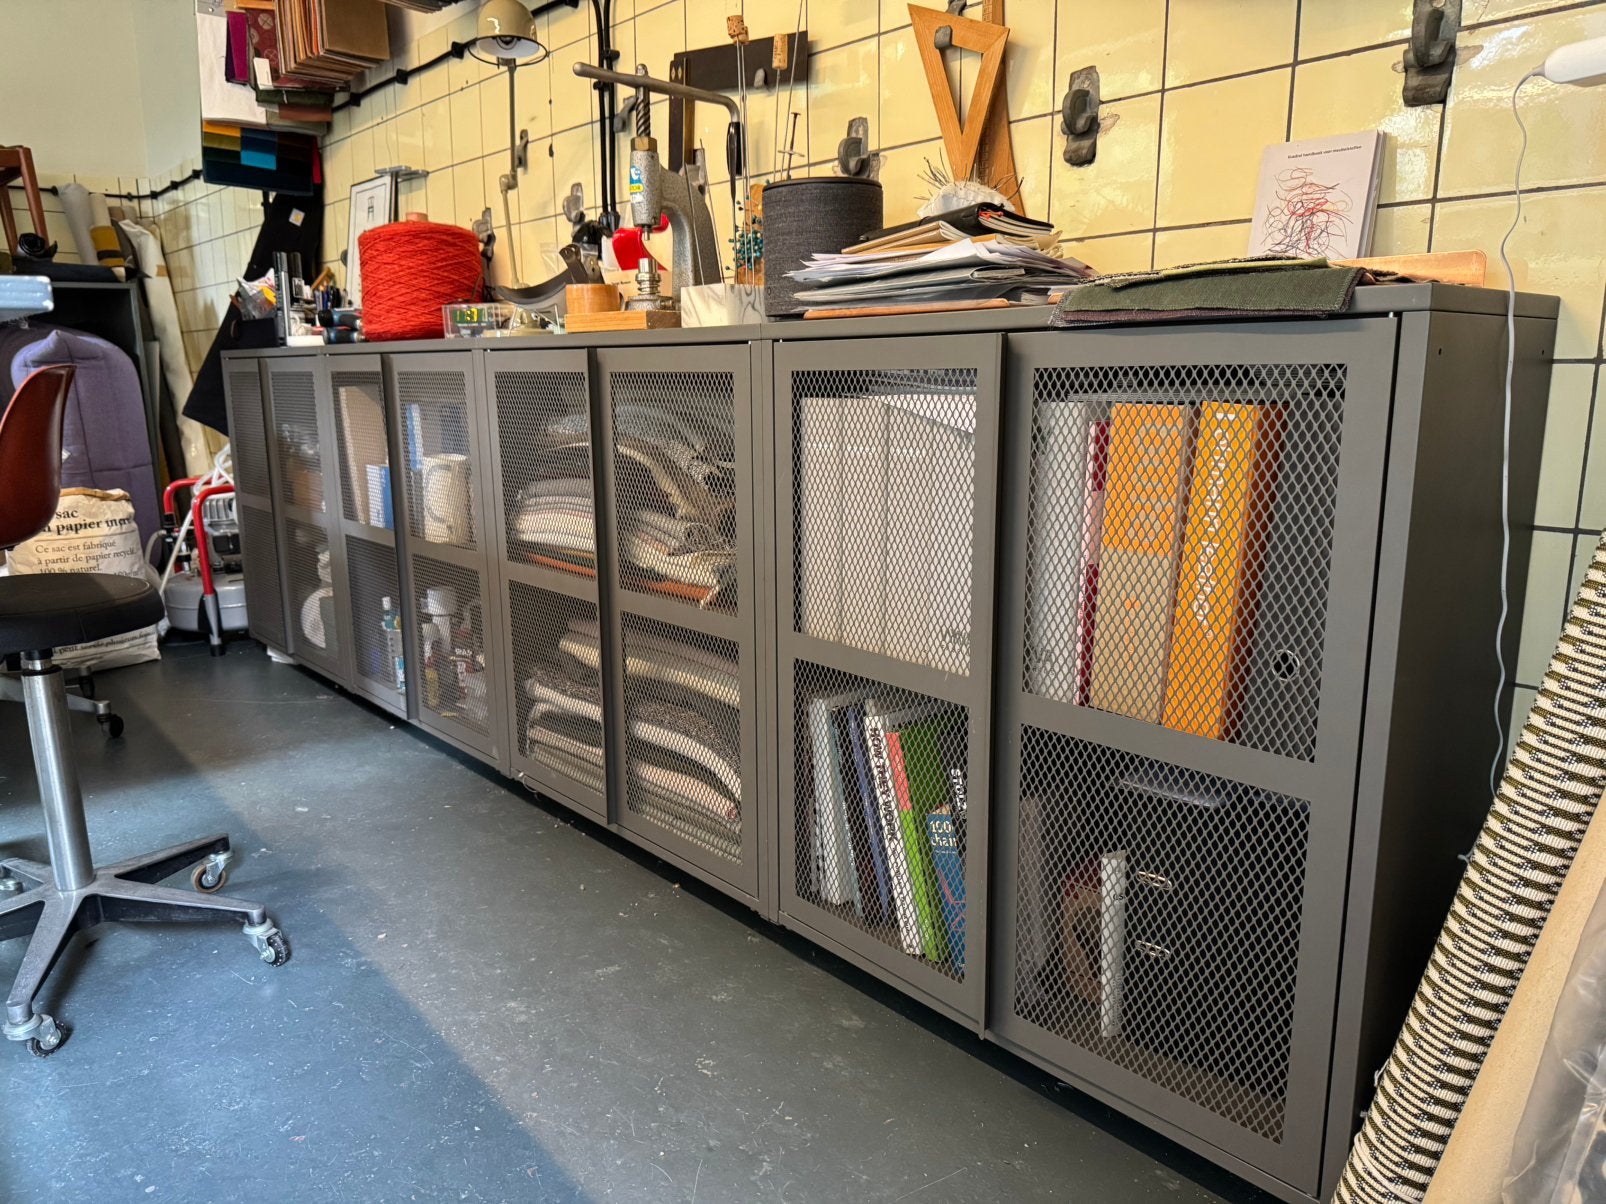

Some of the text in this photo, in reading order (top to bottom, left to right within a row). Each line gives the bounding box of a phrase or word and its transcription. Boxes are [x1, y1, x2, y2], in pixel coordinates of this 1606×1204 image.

[55, 509, 79, 519] sac
[56, 519, 103, 535] papier
[35, 545, 49, 553] Ce
[83, 540, 116, 550] fabriqué
[37, 557, 42, 565] à
[45, 556, 69, 566] partir
[72, 554, 83, 562] de
[85, 552, 111, 563] papier
[869, 726, 899, 843] HOW THEY WORK
